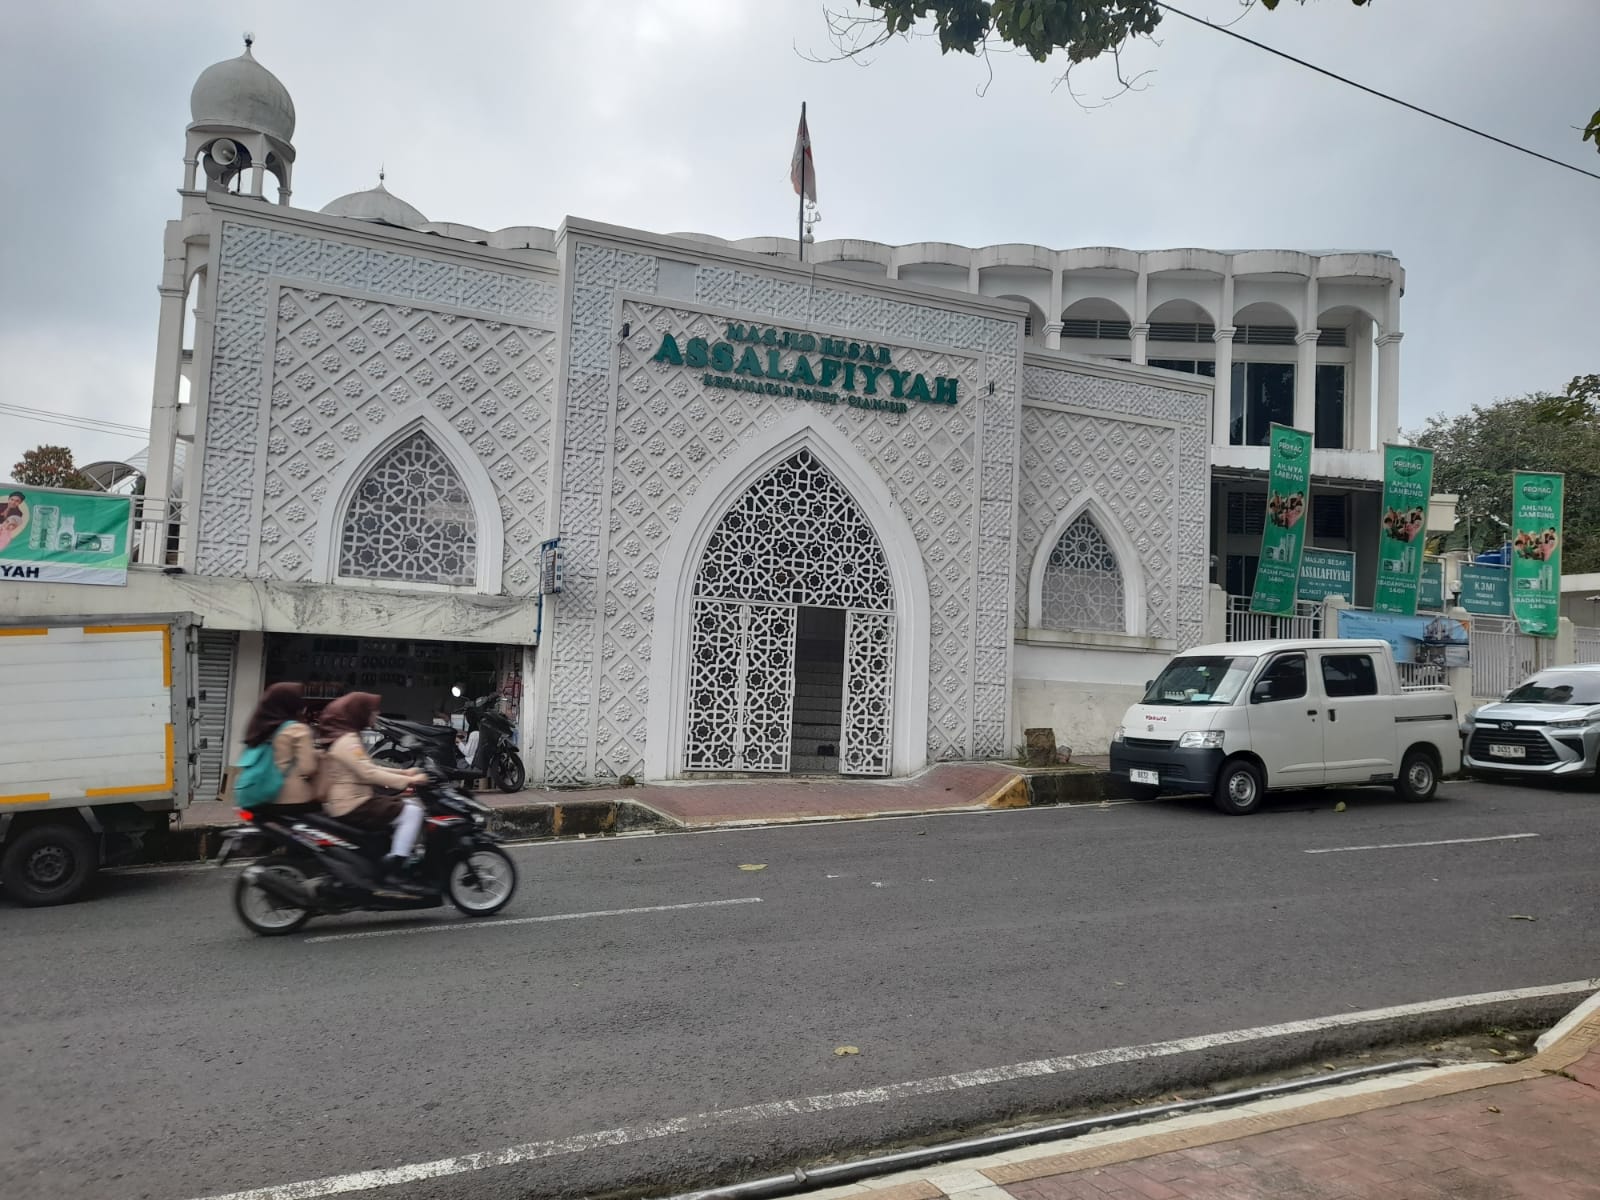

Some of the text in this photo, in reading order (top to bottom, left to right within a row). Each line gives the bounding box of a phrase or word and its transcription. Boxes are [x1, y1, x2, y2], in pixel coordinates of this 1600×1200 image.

[727, 323, 892, 364] MASJID BESAR
[653, 333, 958, 405] ASSALAFIYYAH
[703, 373, 794, 397] KECAMATAN
[797, 388, 839, 405] PACET
[848, 395, 908, 413] CIANJUR
